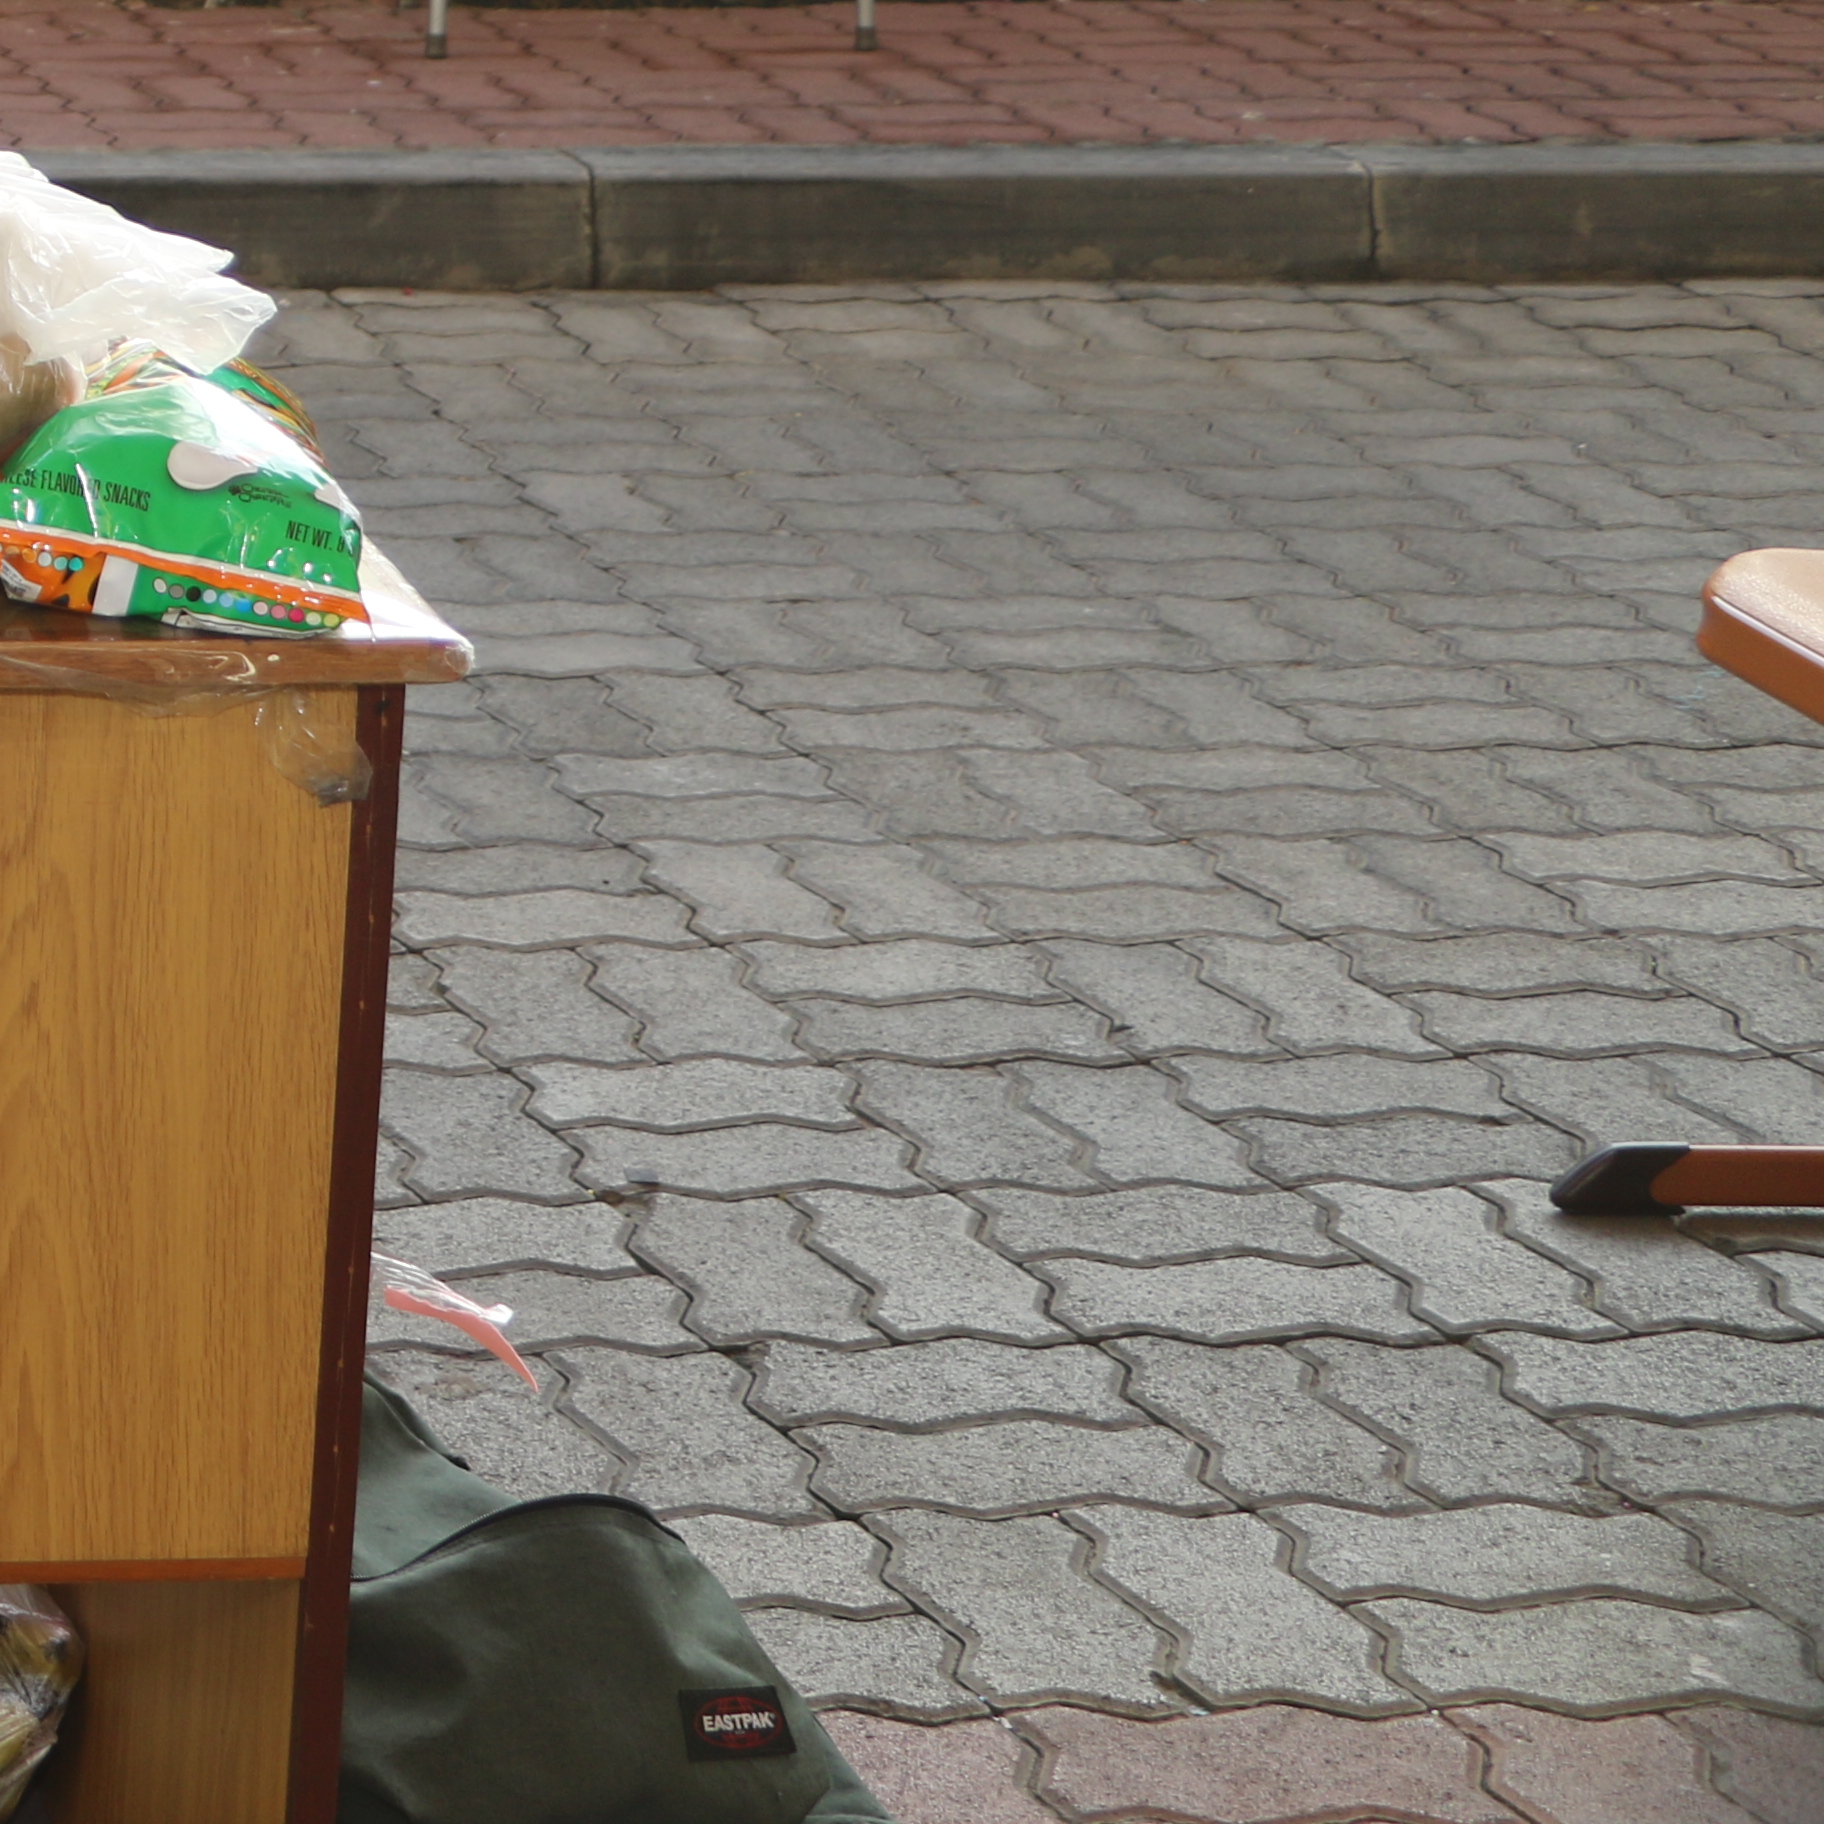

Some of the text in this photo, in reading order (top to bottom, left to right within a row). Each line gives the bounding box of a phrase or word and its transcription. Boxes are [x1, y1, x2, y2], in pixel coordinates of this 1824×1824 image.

[103, 481, 151, 512] SNACKS
[286, 520, 311, 543] NET
[312, 527, 332, 551] WT.
[702, 1711, 774, 1733] EASTPAK
